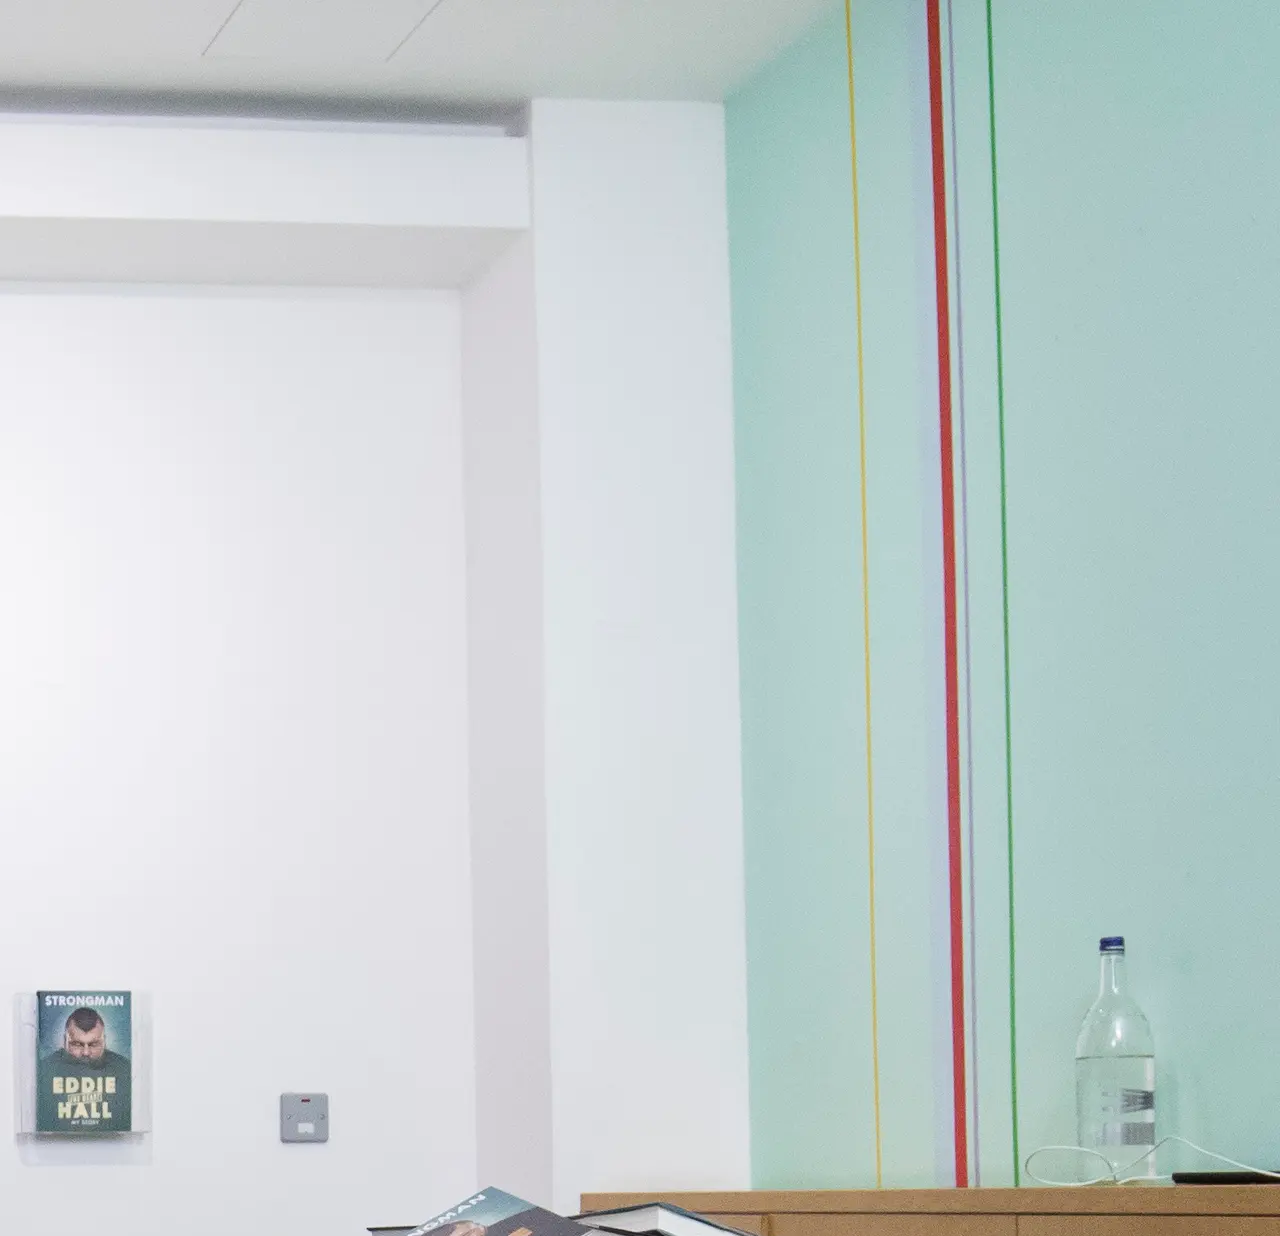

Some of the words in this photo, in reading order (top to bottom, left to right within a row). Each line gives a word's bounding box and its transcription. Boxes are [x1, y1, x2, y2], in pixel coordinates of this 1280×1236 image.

[45, 995, 125, 1007] STRONGMAN
[53, 1076, 116, 1094] EDDIE
[58, 1101, 112, 1119] HALL
